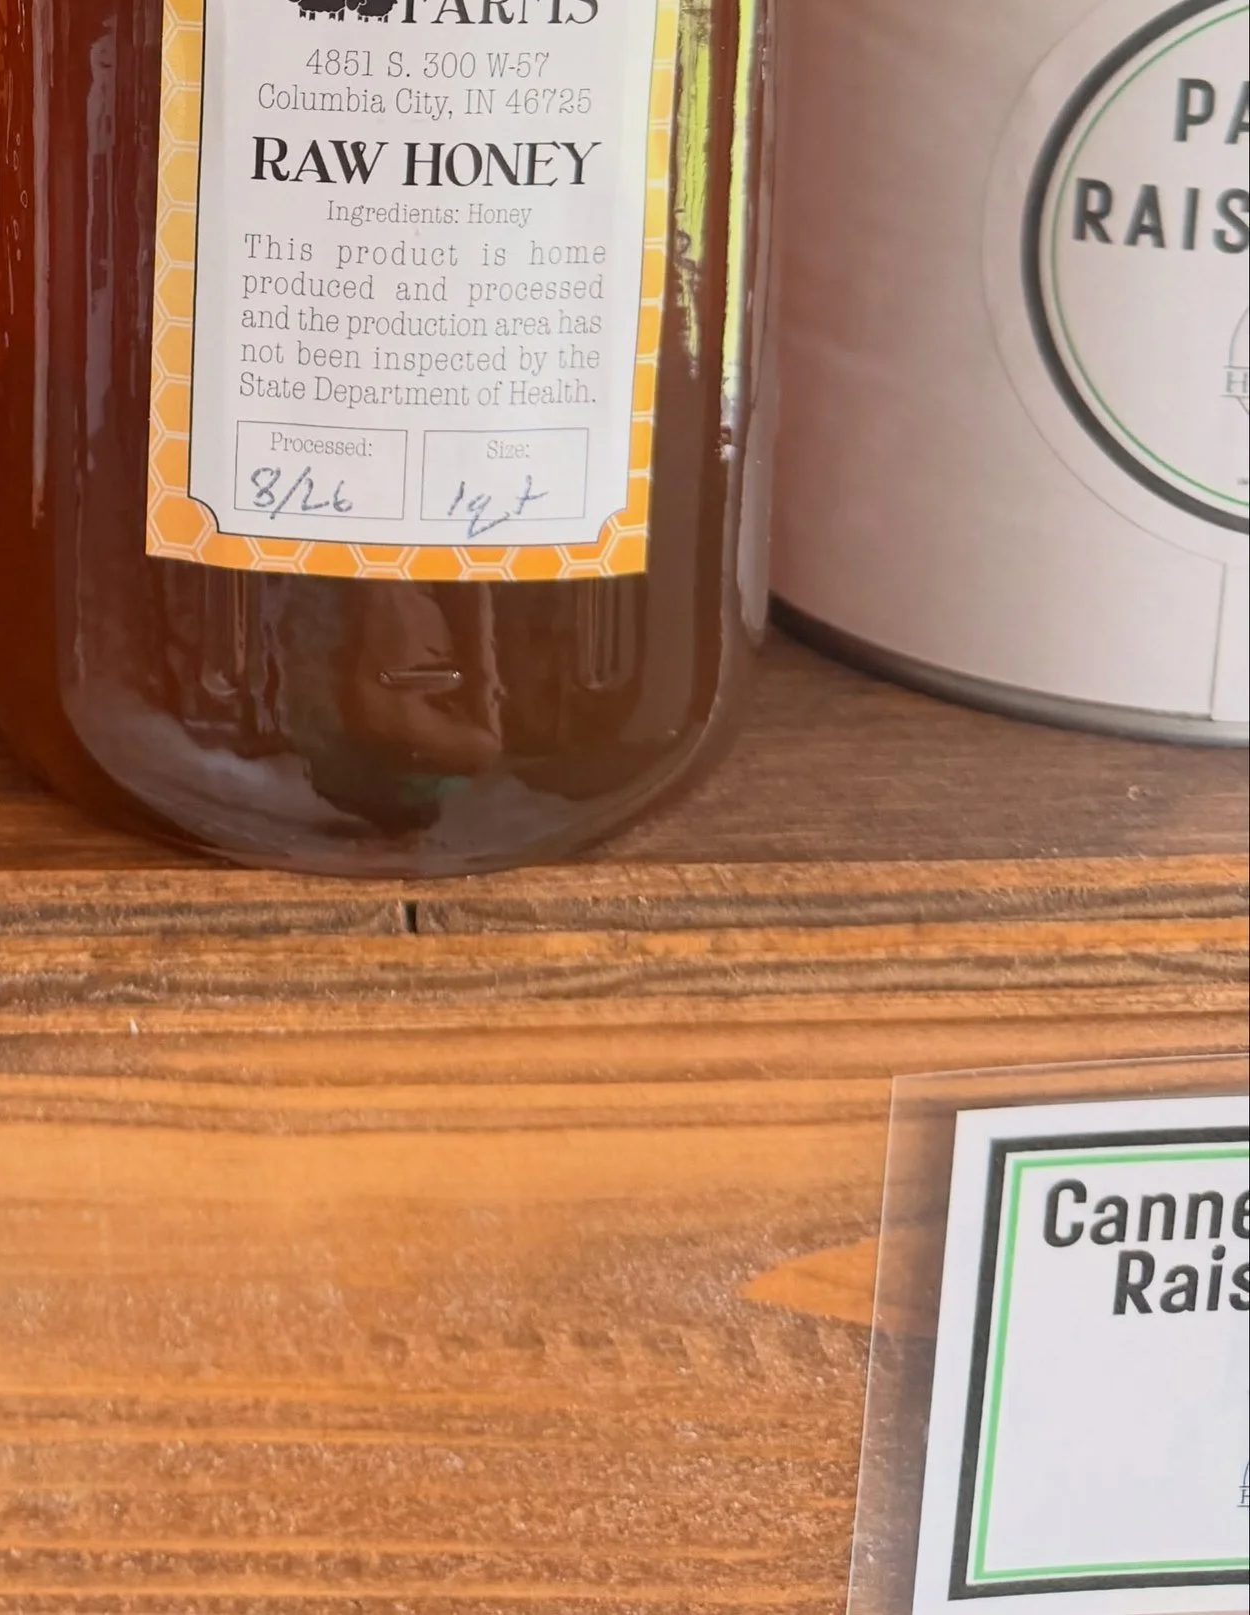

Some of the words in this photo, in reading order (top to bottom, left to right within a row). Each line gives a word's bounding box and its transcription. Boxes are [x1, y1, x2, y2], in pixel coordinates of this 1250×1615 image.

[306, 48, 375, 78] 4851
[387, 51, 411, 78] S.
[423, 52, 477, 78] 300
[487, 52, 550, 79] W-57
[257, 83, 386, 115] Columbia
[395, 87, 454, 122] City,
[465, 88, 495, 115] IN
[504, 88, 592, 115] 46725
[250, 135, 389, 185] RAW
[401, 140, 603, 188] HONEY
[326, 199, 460, 229] Ingredients:
[467, 203, 532, 228] Honey
[1071, 177, 1249, 254] RAIS
[244, 233, 313, 263] This
[336, 241, 458, 269] product
[482, 242, 507, 266] is
[530, 240, 607, 266] home
[242, 272, 374, 300] produced
[396, 277, 447, 302] and
[467, 273, 604, 303] processed
[241, 306, 289, 332] and
[298, 308, 339, 334] the
[347, 311, 488, 340] production
[495, 315, 551, 336] area
[557, 309, 602, 335] has
[240, 343, 285, 365] not
[297, 340, 361, 370] been
[373, 344, 507, 377] inspected
[519, 344, 547, 376] by
[557, 343, 600, 369] the
[239, 371, 307, 401] State
[312, 376, 470, 410] Department
[477, 380, 503, 406] of
[508, 380, 597, 405] Health.
[269, 431, 373, 458] Processed:
[486, 440, 531, 461] Size:
[1042, 1177, 1249, 1248] Canne
[1112, 1244, 1249, 1316] Rais
